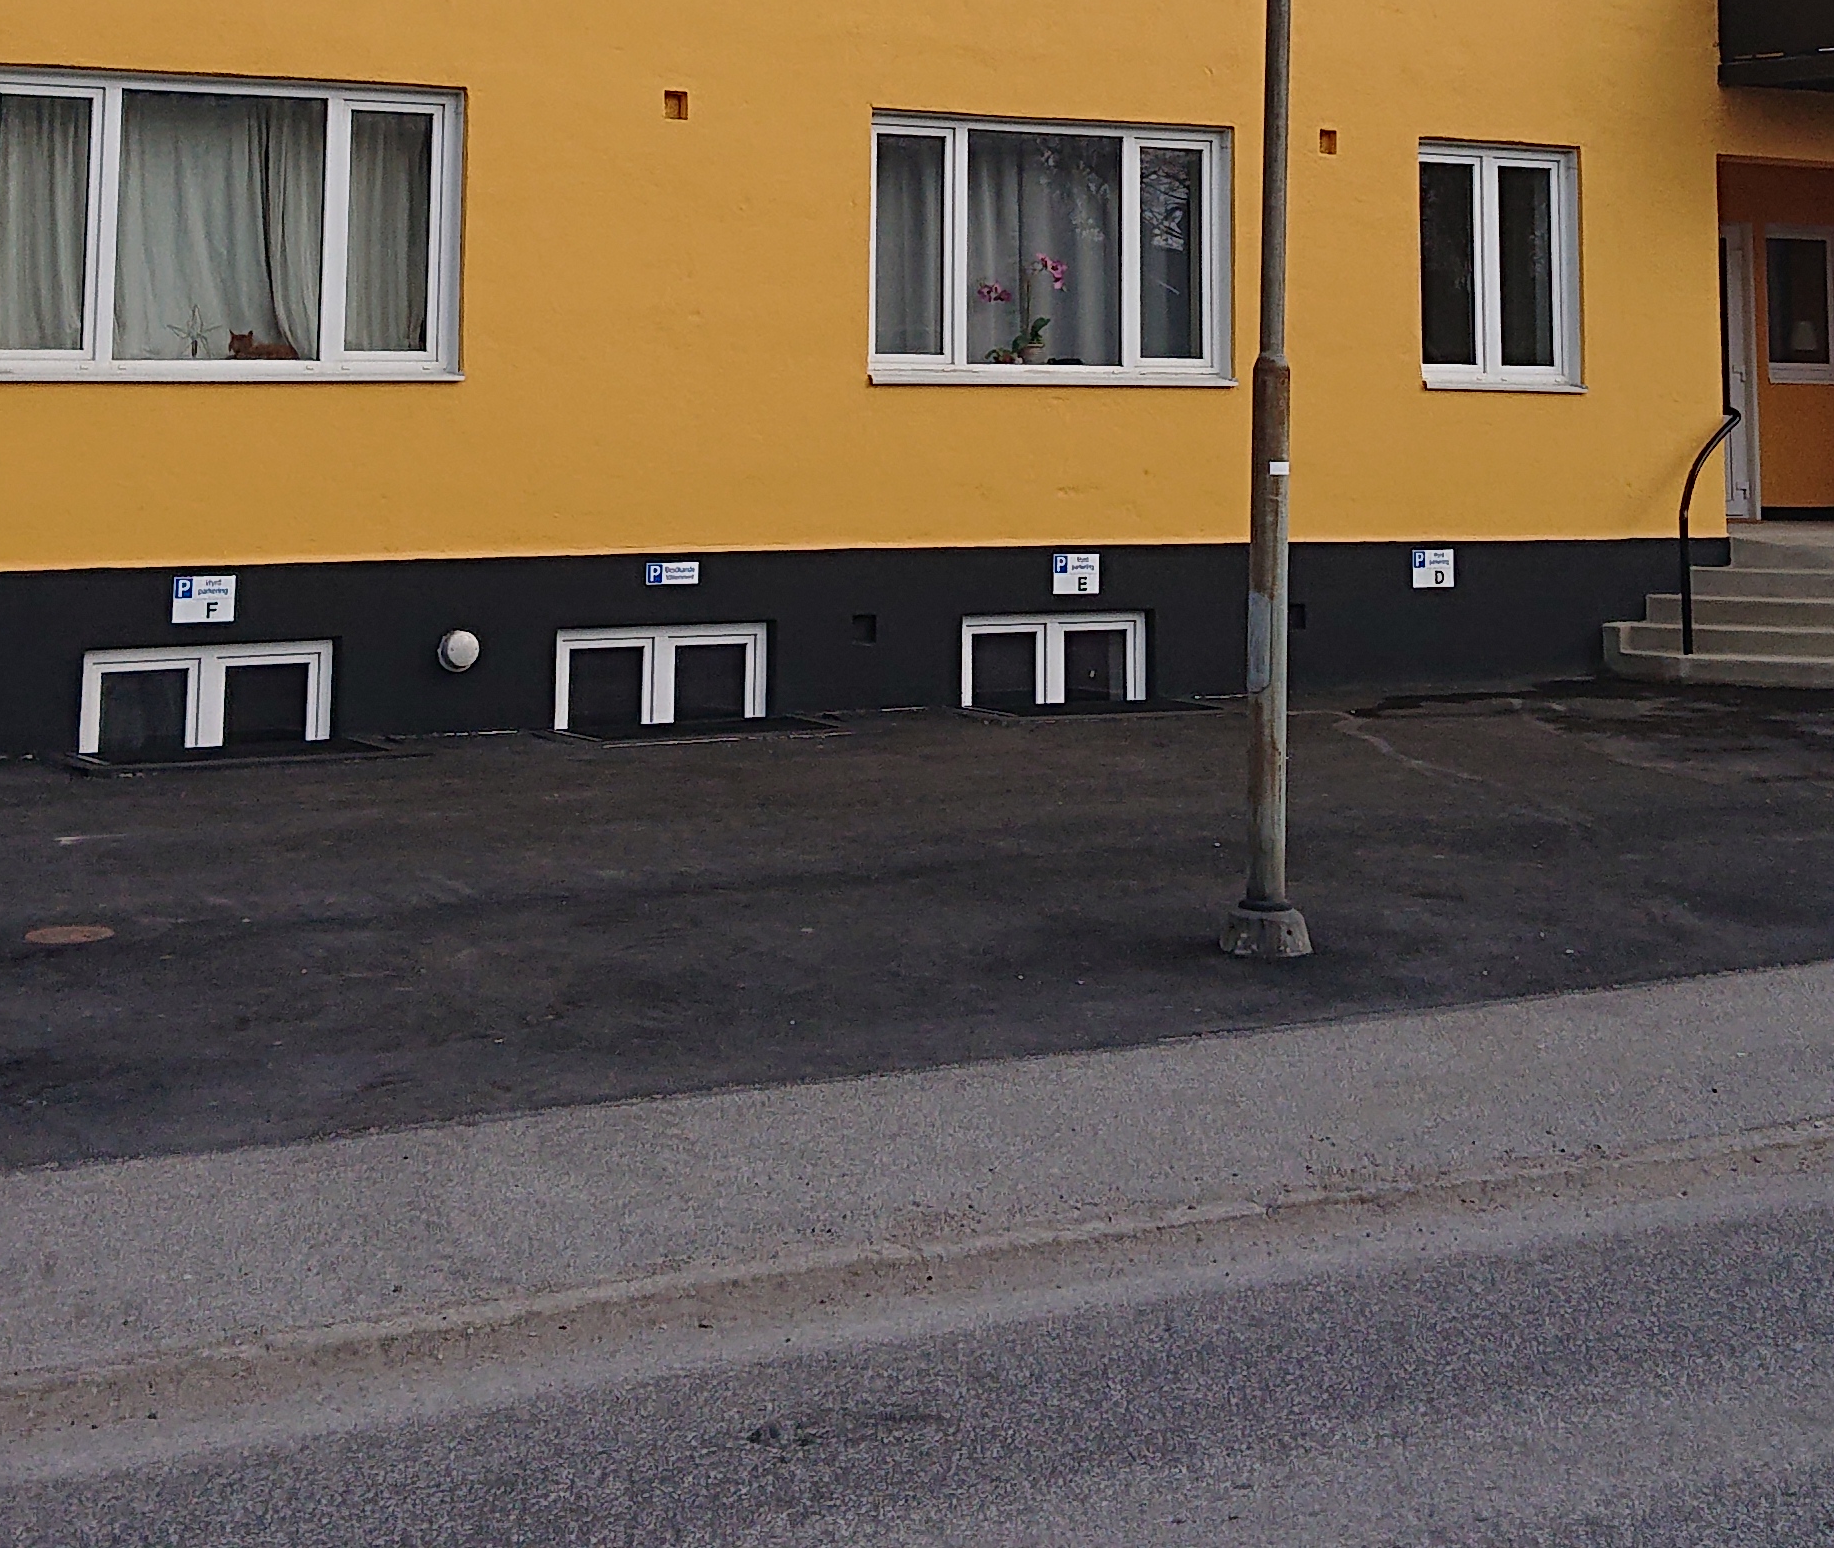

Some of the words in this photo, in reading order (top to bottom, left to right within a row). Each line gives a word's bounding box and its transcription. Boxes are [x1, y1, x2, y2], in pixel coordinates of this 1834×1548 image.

[1057, 557, 1066, 572] P
[1415, 552, 1425, 567] P
[650, 566, 660, 581] P
[1435, 570, 1444, 584] D
[178, 580, 191, 597] P
[1078, 576, 1087, 591] E
[206, 602, 218, 618] F
